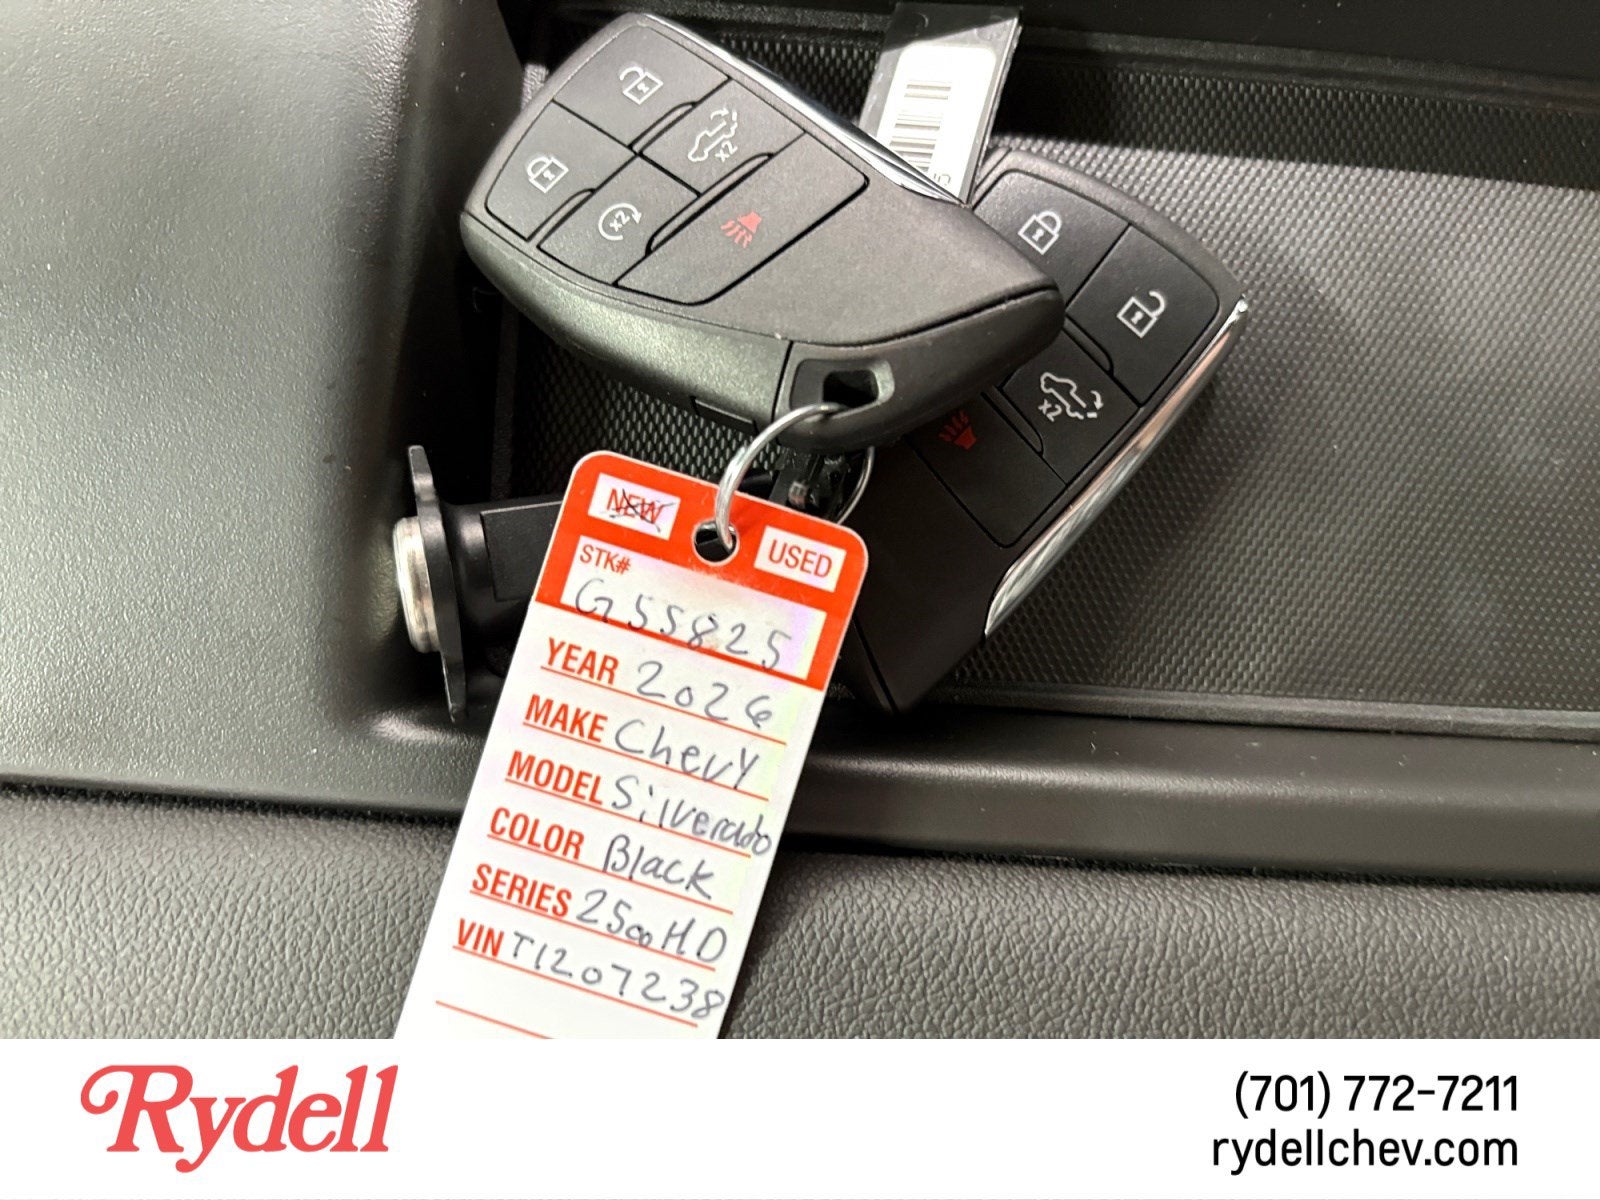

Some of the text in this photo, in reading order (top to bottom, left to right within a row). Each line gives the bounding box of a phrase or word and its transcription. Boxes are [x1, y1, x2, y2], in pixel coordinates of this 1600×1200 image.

[606, 488, 664, 525] NEW
[579, 544, 631, 575] STK#
[768, 539, 833, 578] USED
[575, 578, 792, 671] G55825
[547, 637, 619, 685] YEAR
[524, 694, 608, 743] MAKE
[636, 661, 773, 728] 2026
[507, 750, 603, 805] MODEL
[489, 806, 585, 859] COLOR
[611, 774, 772, 857] Silverado
[472, 863, 572, 918] SERIES
[602, 833, 714, 901] Black
[455, 918, 505, 958] VIN
[512, 930, 726, 1019] T1207238
